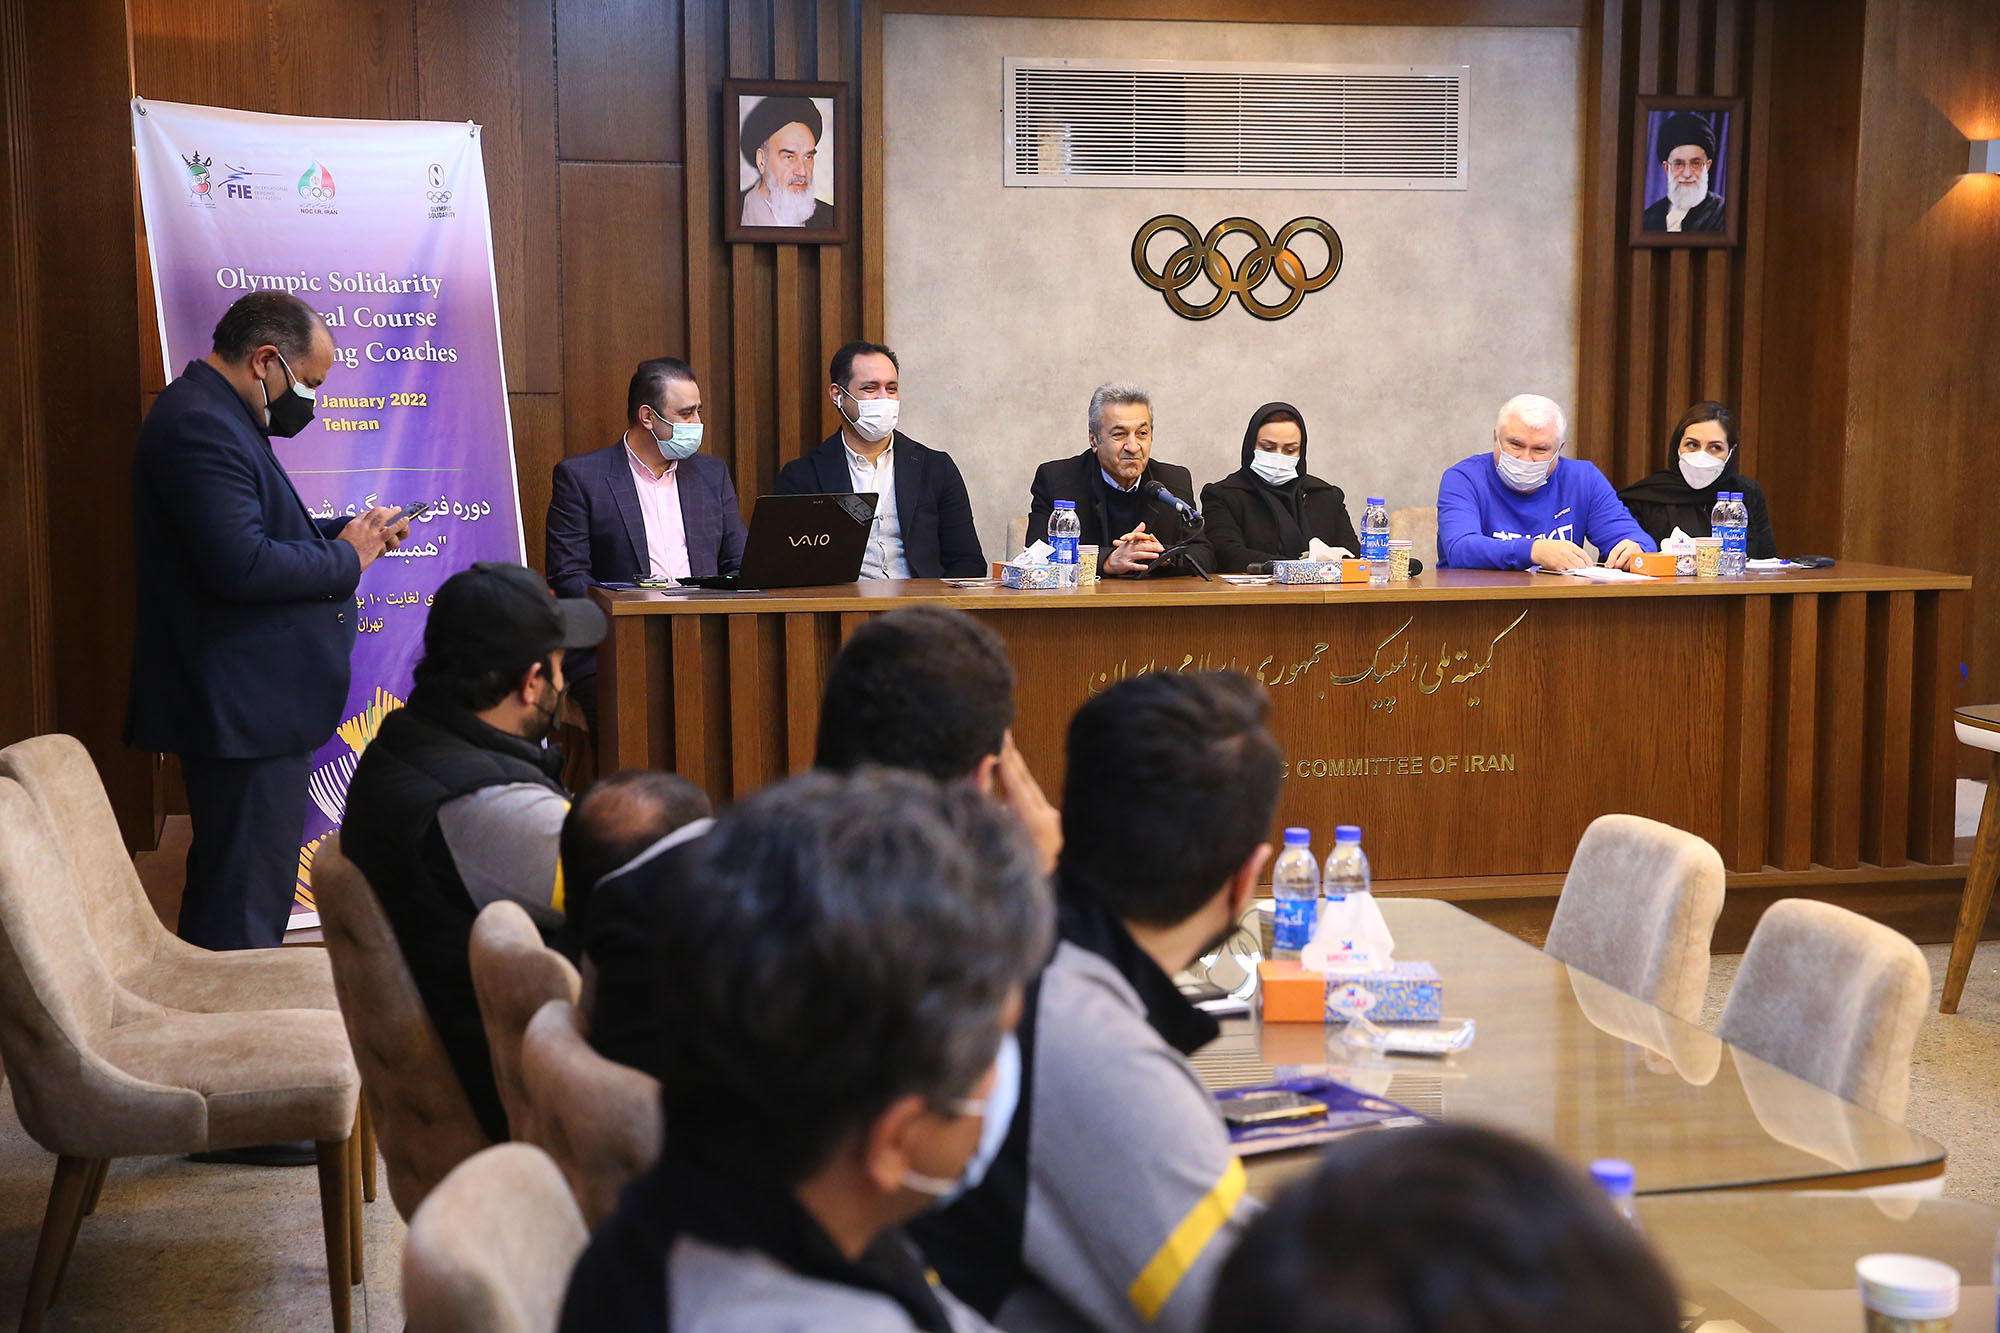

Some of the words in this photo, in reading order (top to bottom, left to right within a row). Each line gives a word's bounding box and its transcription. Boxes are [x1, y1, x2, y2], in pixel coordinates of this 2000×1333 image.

[227, 184, 252, 199] FIE
[216, 267, 322, 296] Olympic
[328, 271, 442, 299] Solidarity
[353, 307, 437, 328] Course
[365, 340, 458, 363] Coaches
[321, 394, 386, 410] January
[389, 392, 428, 407] 2022
[322, 417, 380, 431] Tehran
[416, 495, 450, 523] فنی
[453, 499, 491, 521] دوره
[788, 533, 831, 547] VAIO
[386, 590, 420, 609] لغایت
[357, 616, 385, 633] تهران
[1296, 756, 1424, 778] COMMITTEE
[1429, 755, 1460, 774] OF
[1464, 753, 1516, 773] IRAN
